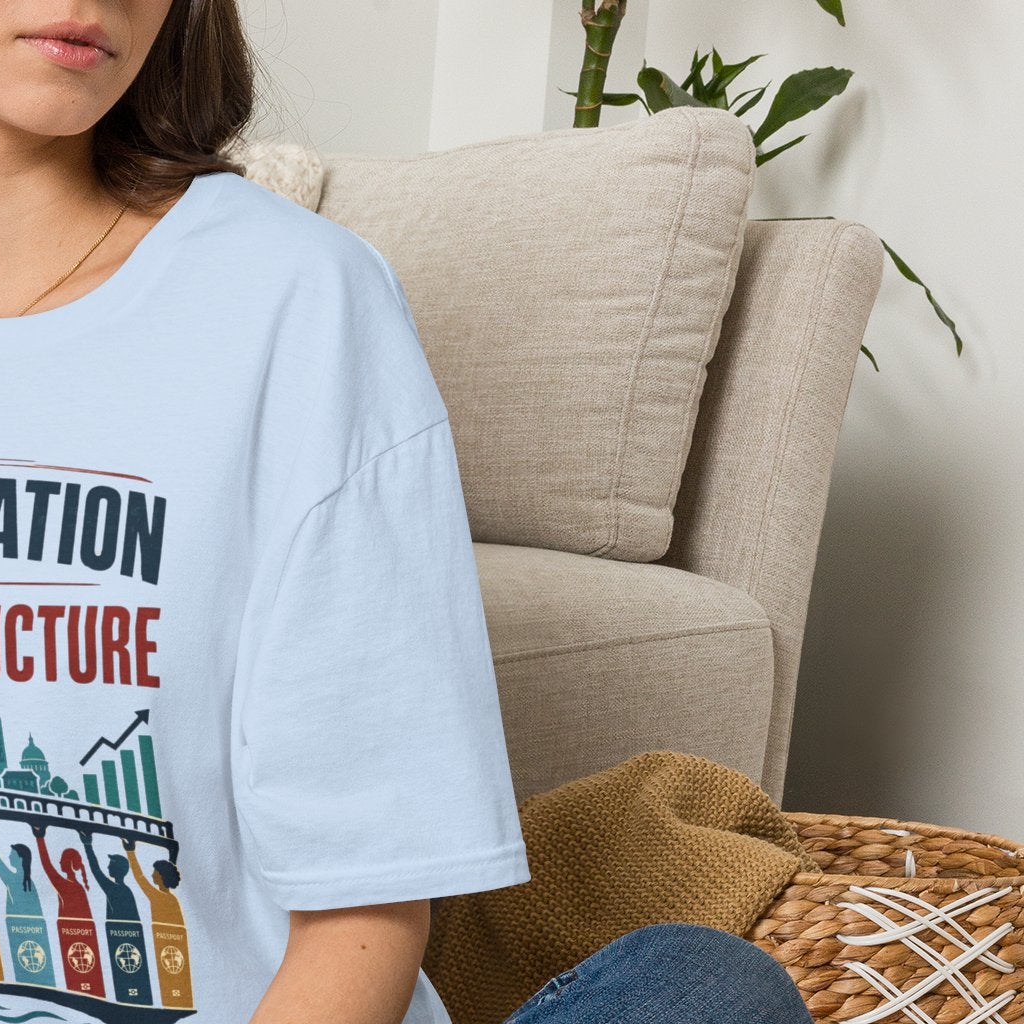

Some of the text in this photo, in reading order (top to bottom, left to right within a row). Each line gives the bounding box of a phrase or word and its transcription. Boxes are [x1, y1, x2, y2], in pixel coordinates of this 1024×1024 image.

[11, 925, 43, 934] PASSPORT
[61, 927, 93, 937] PASSPORT
[109, 929, 140, 938] PASSPORT
[156, 932, 184, 941] PASSPORT
